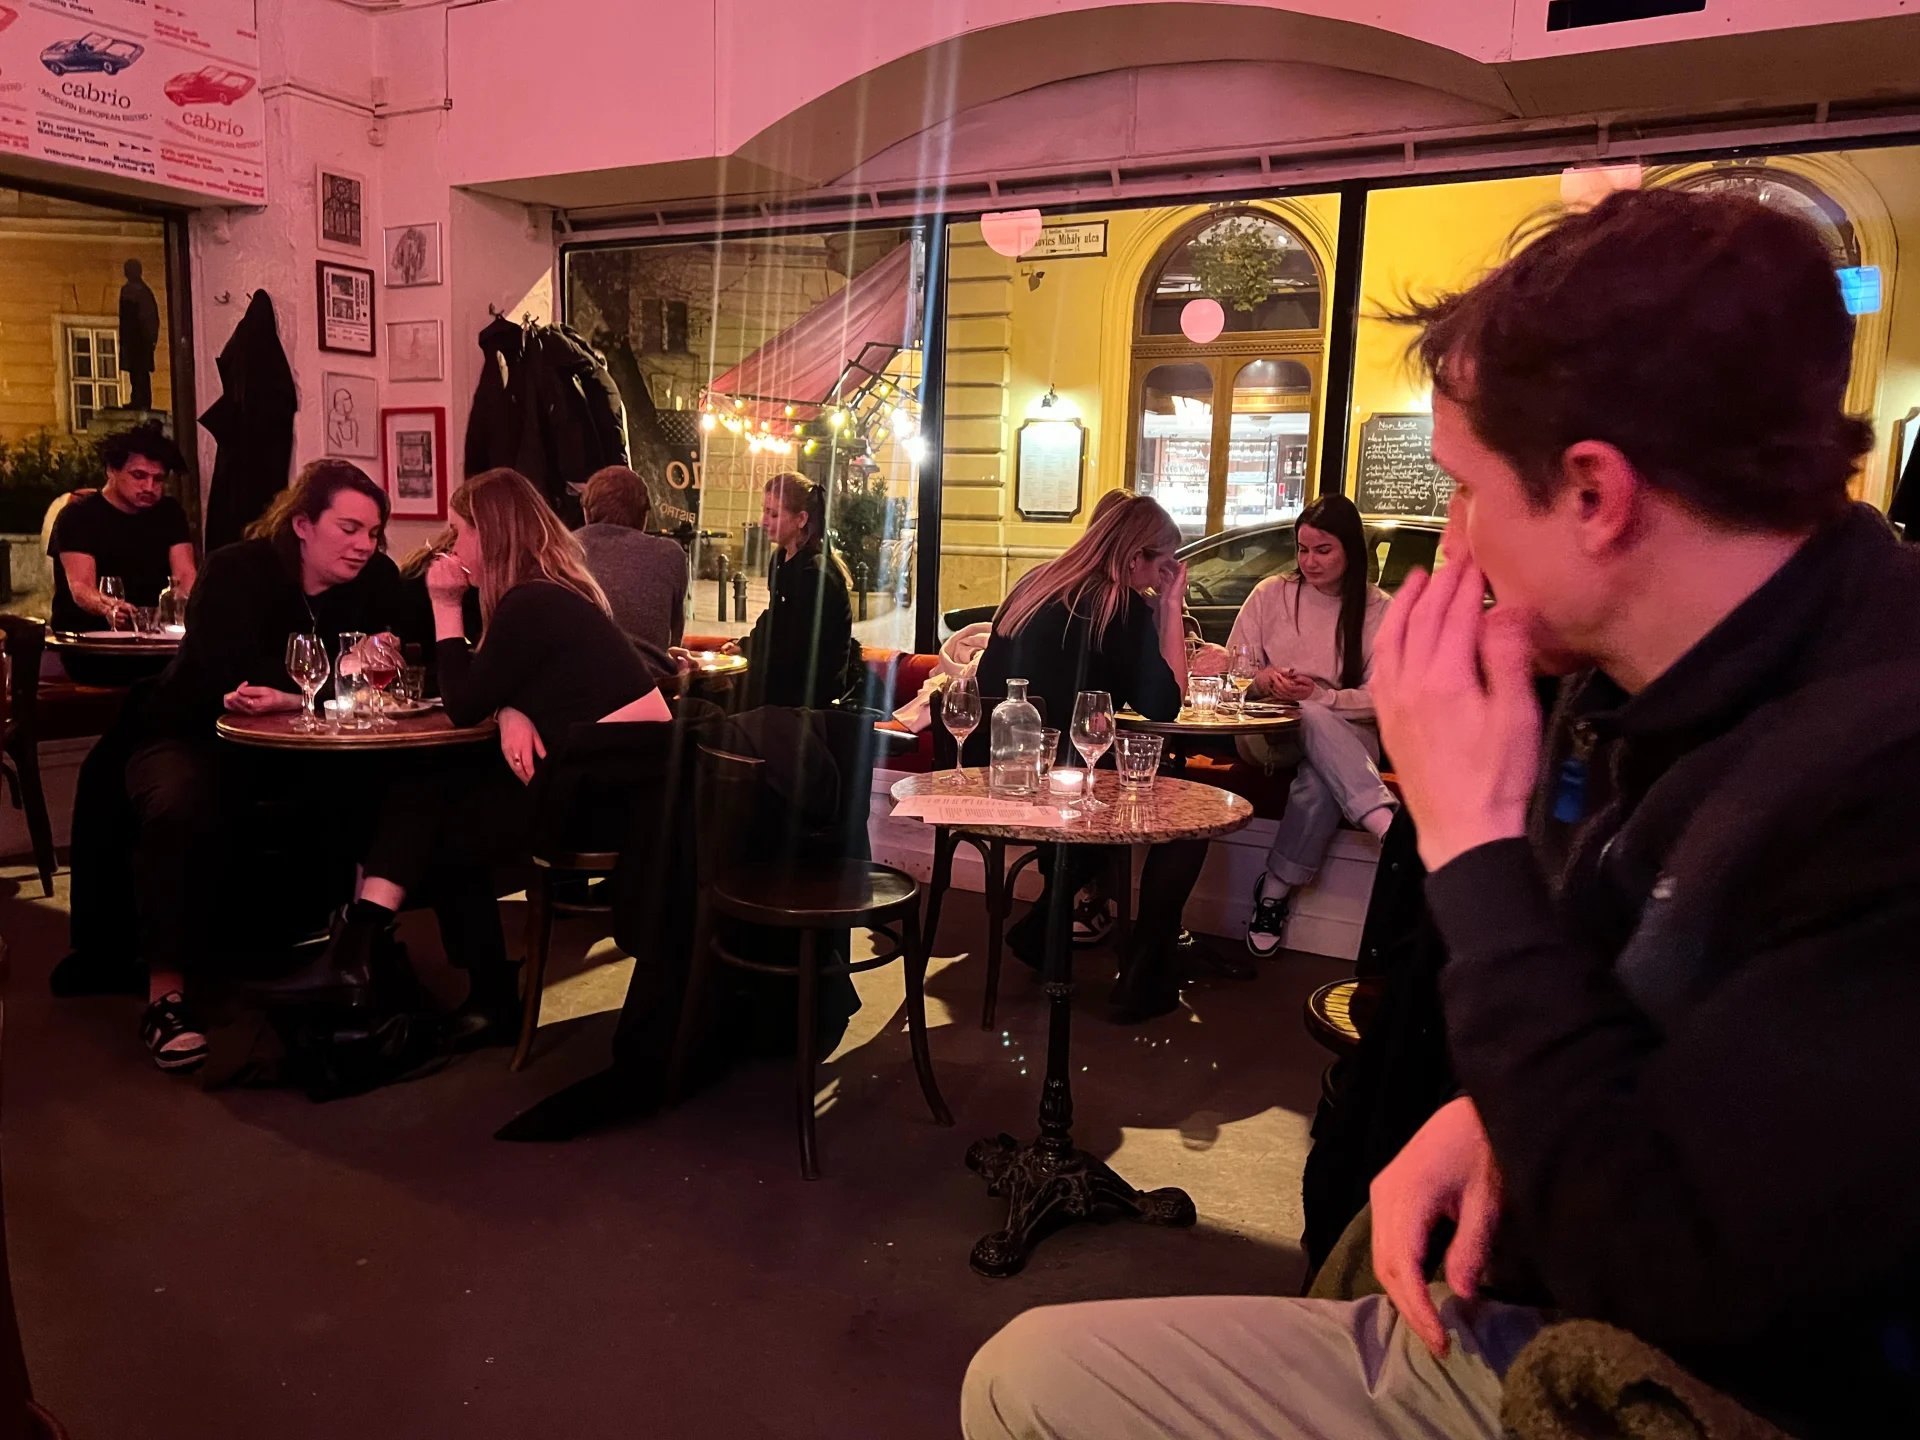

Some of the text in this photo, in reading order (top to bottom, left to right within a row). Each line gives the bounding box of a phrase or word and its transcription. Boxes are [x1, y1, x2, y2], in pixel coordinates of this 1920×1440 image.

[62, 82, 131, 110] cabrio
[78, 106, 121, 121] EUROPEAN
[182, 112, 244, 137] cabrio
